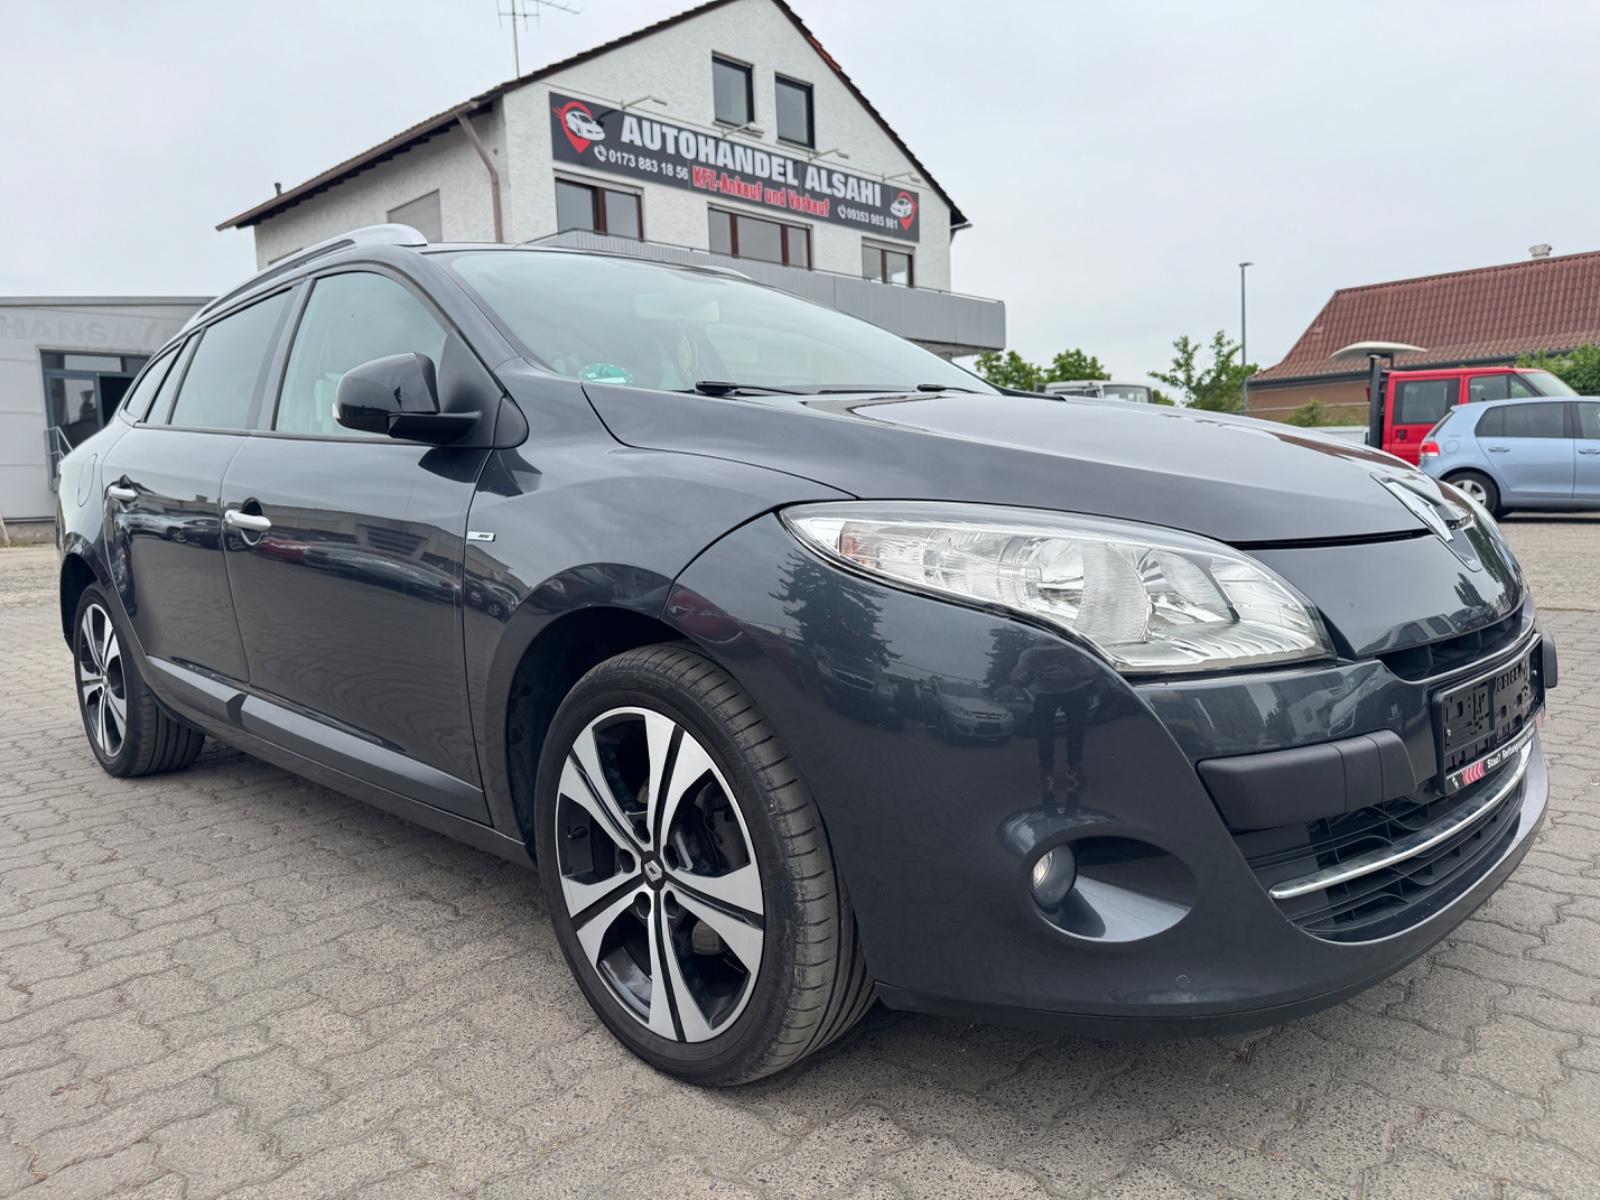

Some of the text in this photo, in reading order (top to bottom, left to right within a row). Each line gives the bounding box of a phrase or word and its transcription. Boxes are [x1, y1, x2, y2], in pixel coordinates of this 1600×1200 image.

[608, 149, 689, 180] 0173 883 18 56
[621, 114, 882, 208] AUTOHANDEL ALSAHI
[692, 165, 830, 217] KFZ-Ankauf und Verkauf
[847, 208, 869, 223] 09353
